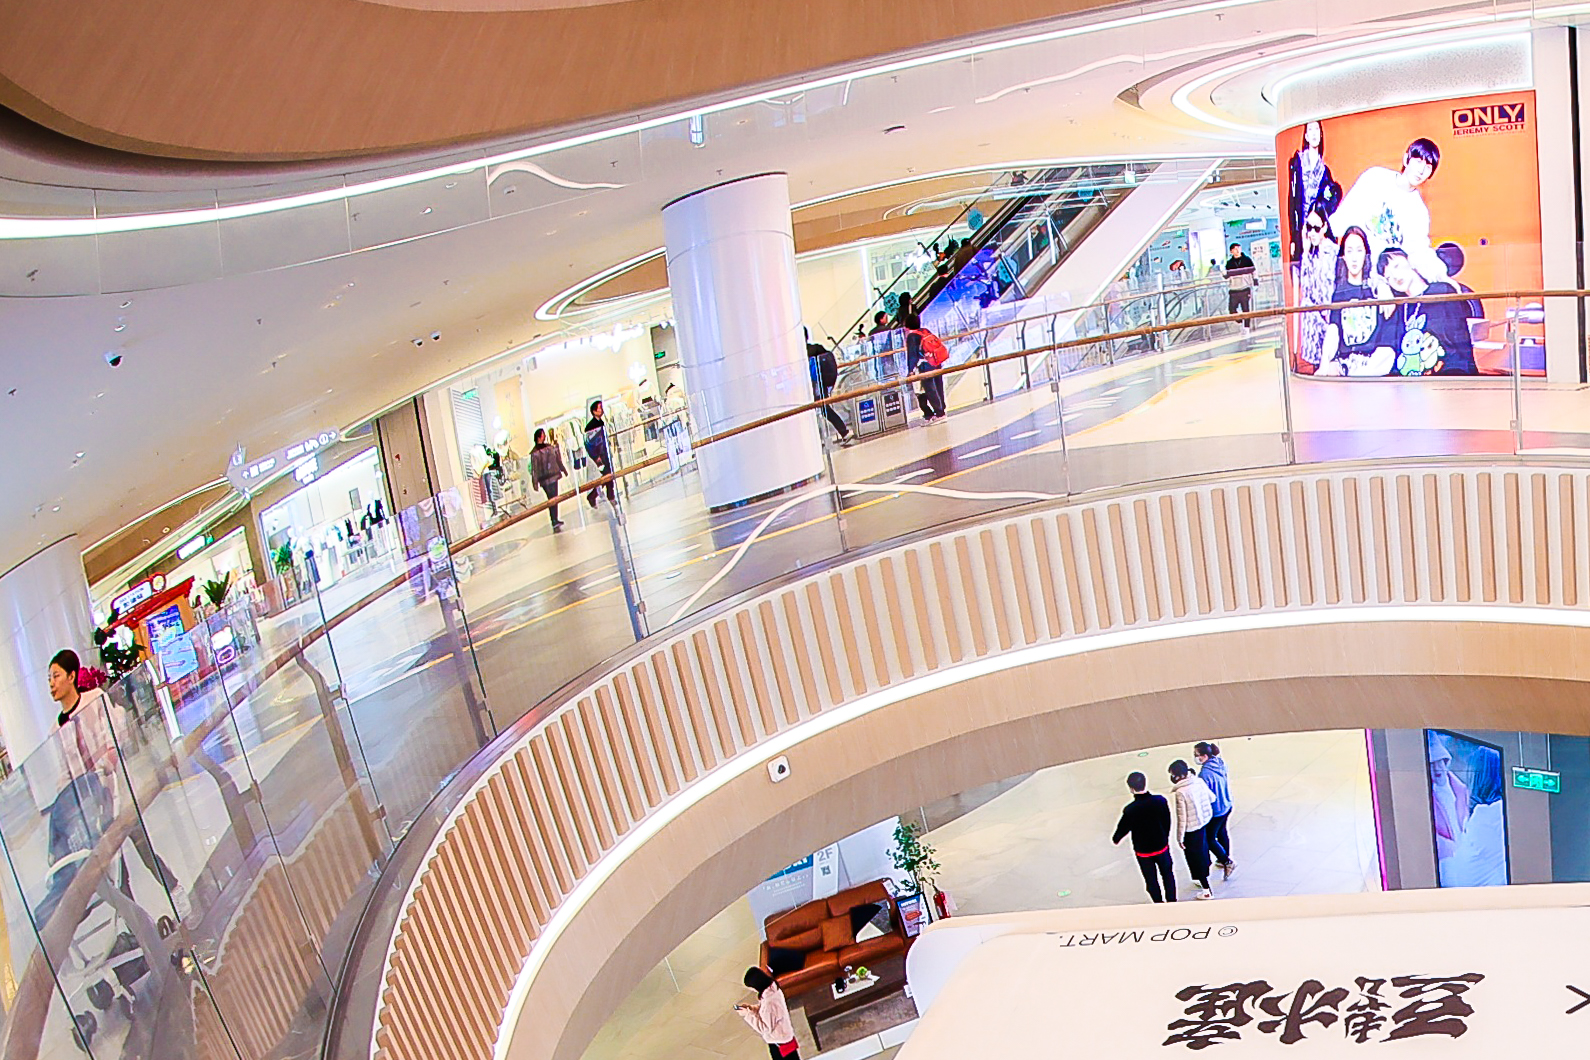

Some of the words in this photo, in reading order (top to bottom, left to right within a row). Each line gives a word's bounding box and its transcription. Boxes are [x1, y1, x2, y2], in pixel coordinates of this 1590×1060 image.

[1453, 127, 1490, 136] JEREMY
[1493, 123, 1525, 132] SCOTT
[816, 847, 834, 863] 2F
[1150, 926, 1212, 941] POP
